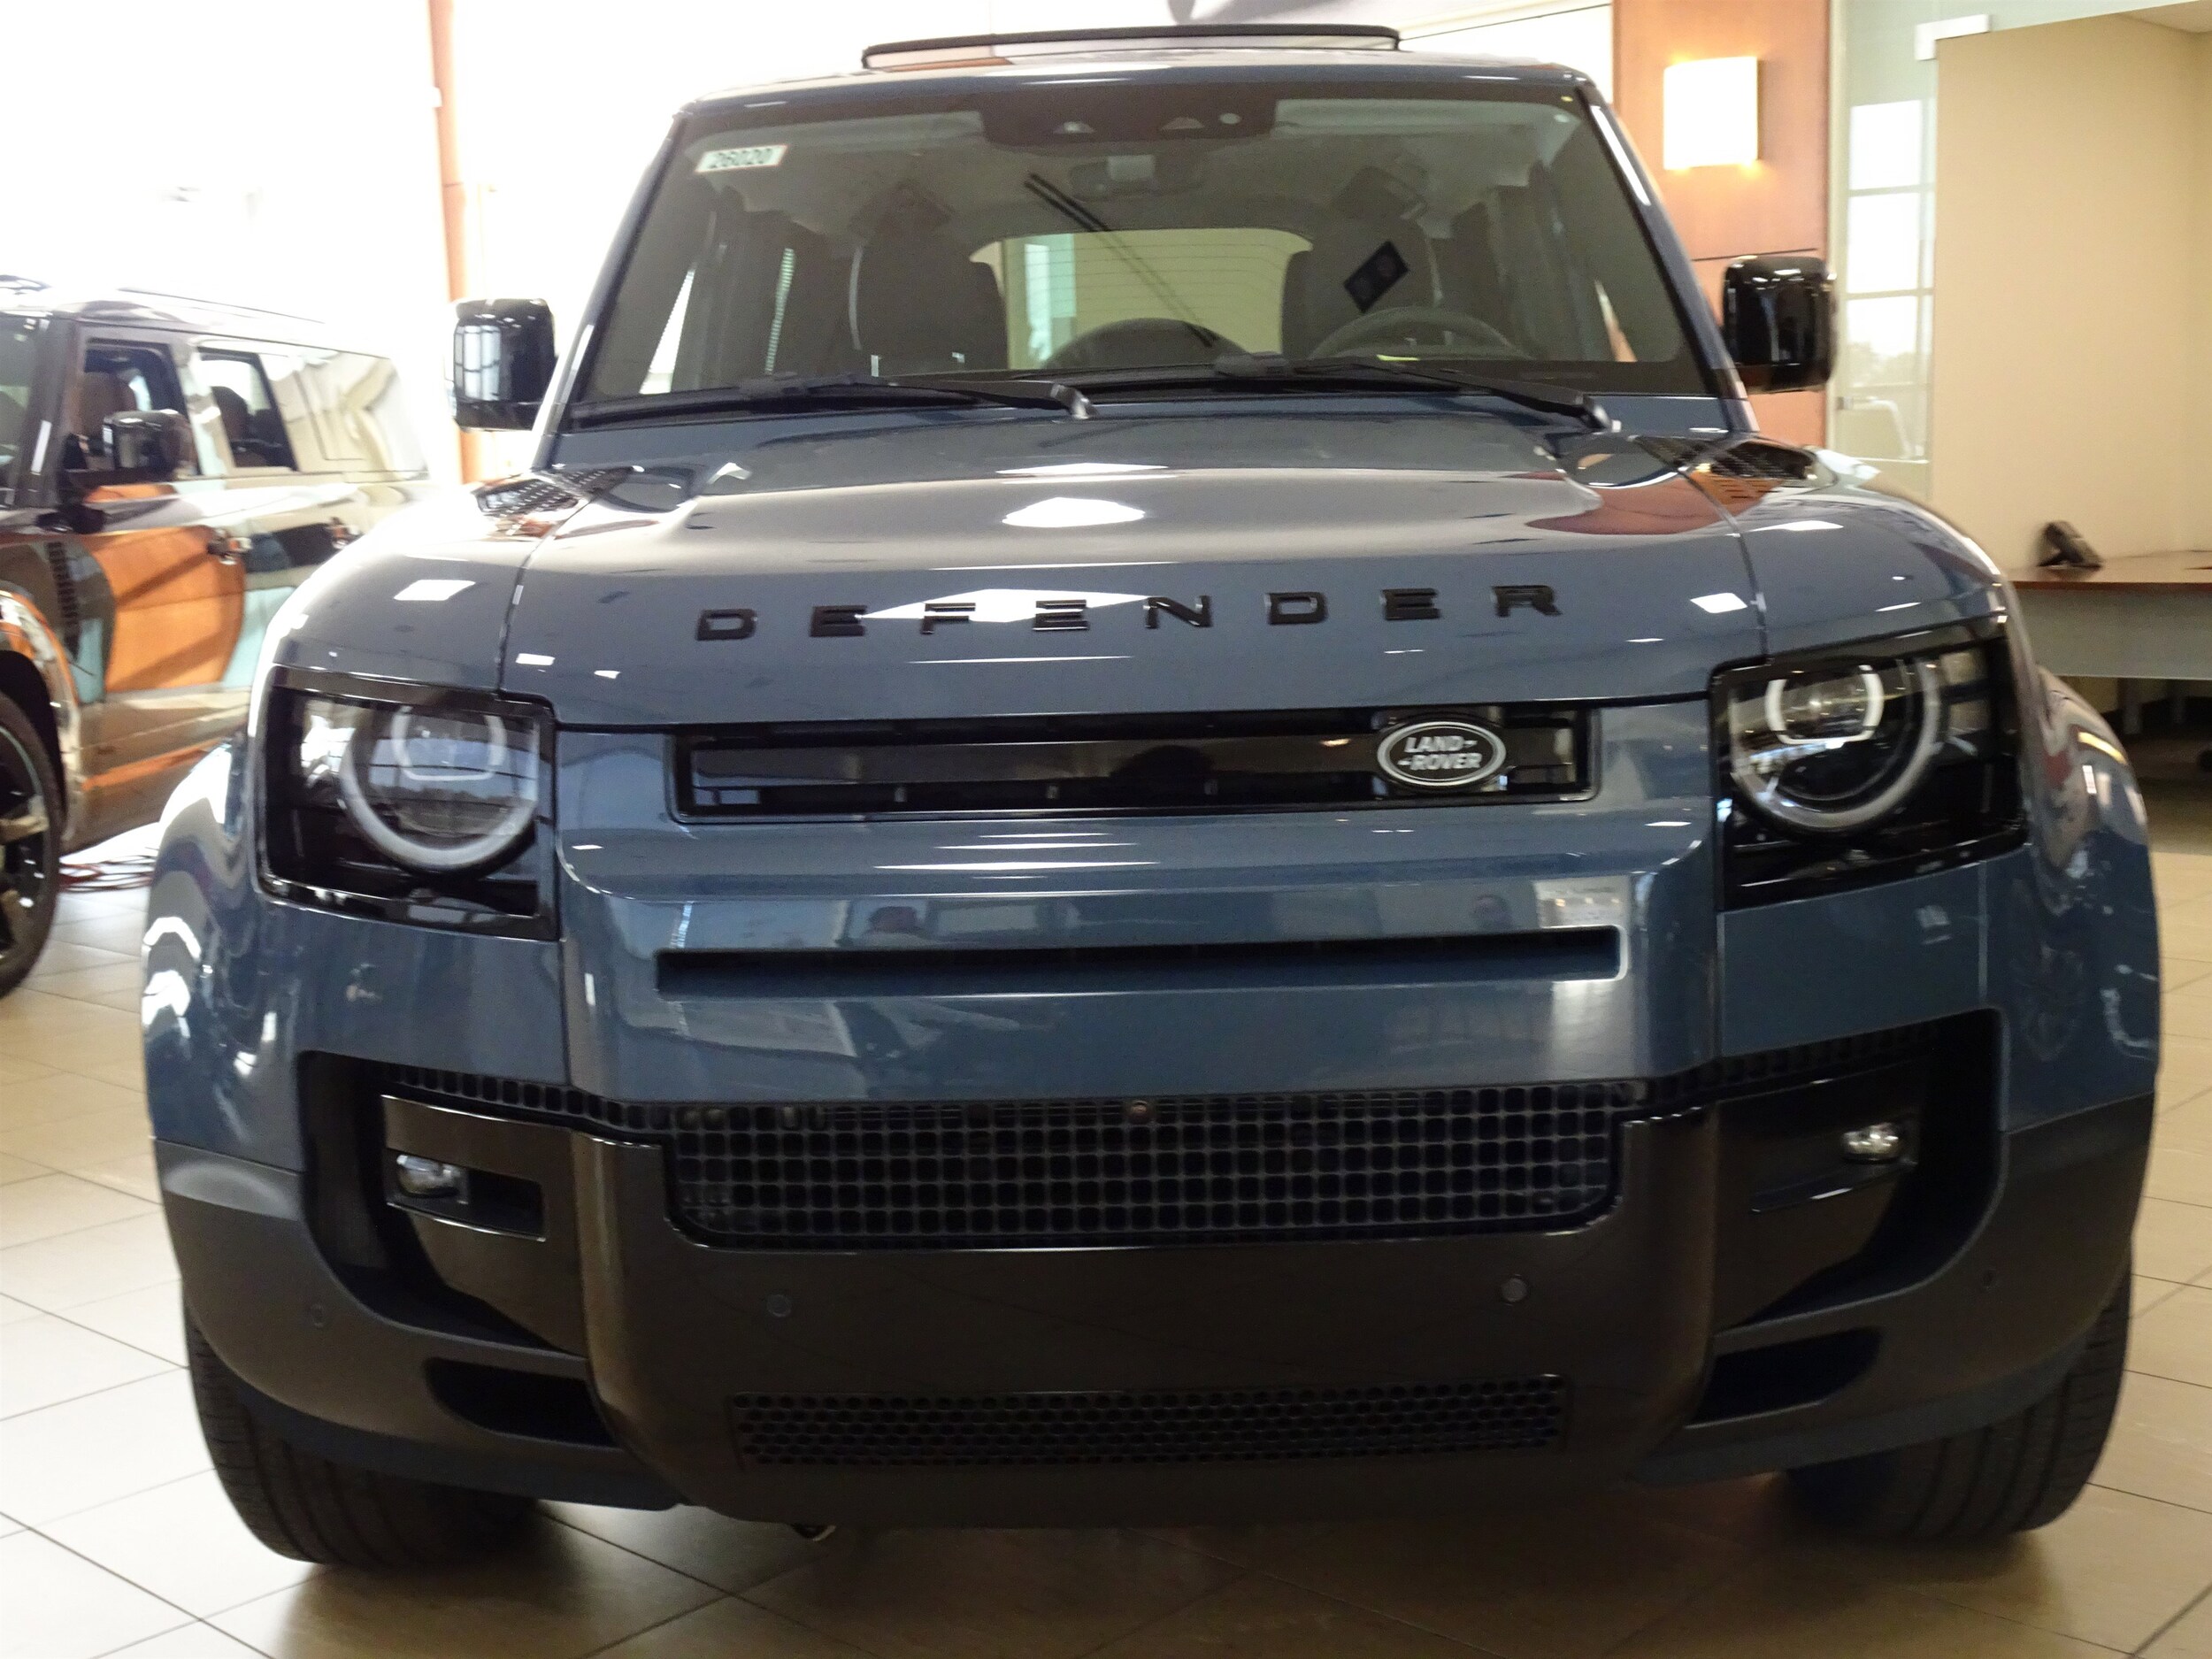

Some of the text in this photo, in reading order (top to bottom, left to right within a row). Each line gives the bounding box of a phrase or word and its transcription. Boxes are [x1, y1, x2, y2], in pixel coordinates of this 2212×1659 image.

[696, 585, 1562, 641] DEFENDER
[1404, 735, 1464, 753] LAND
[1410, 753, 1482, 770] ROVER
